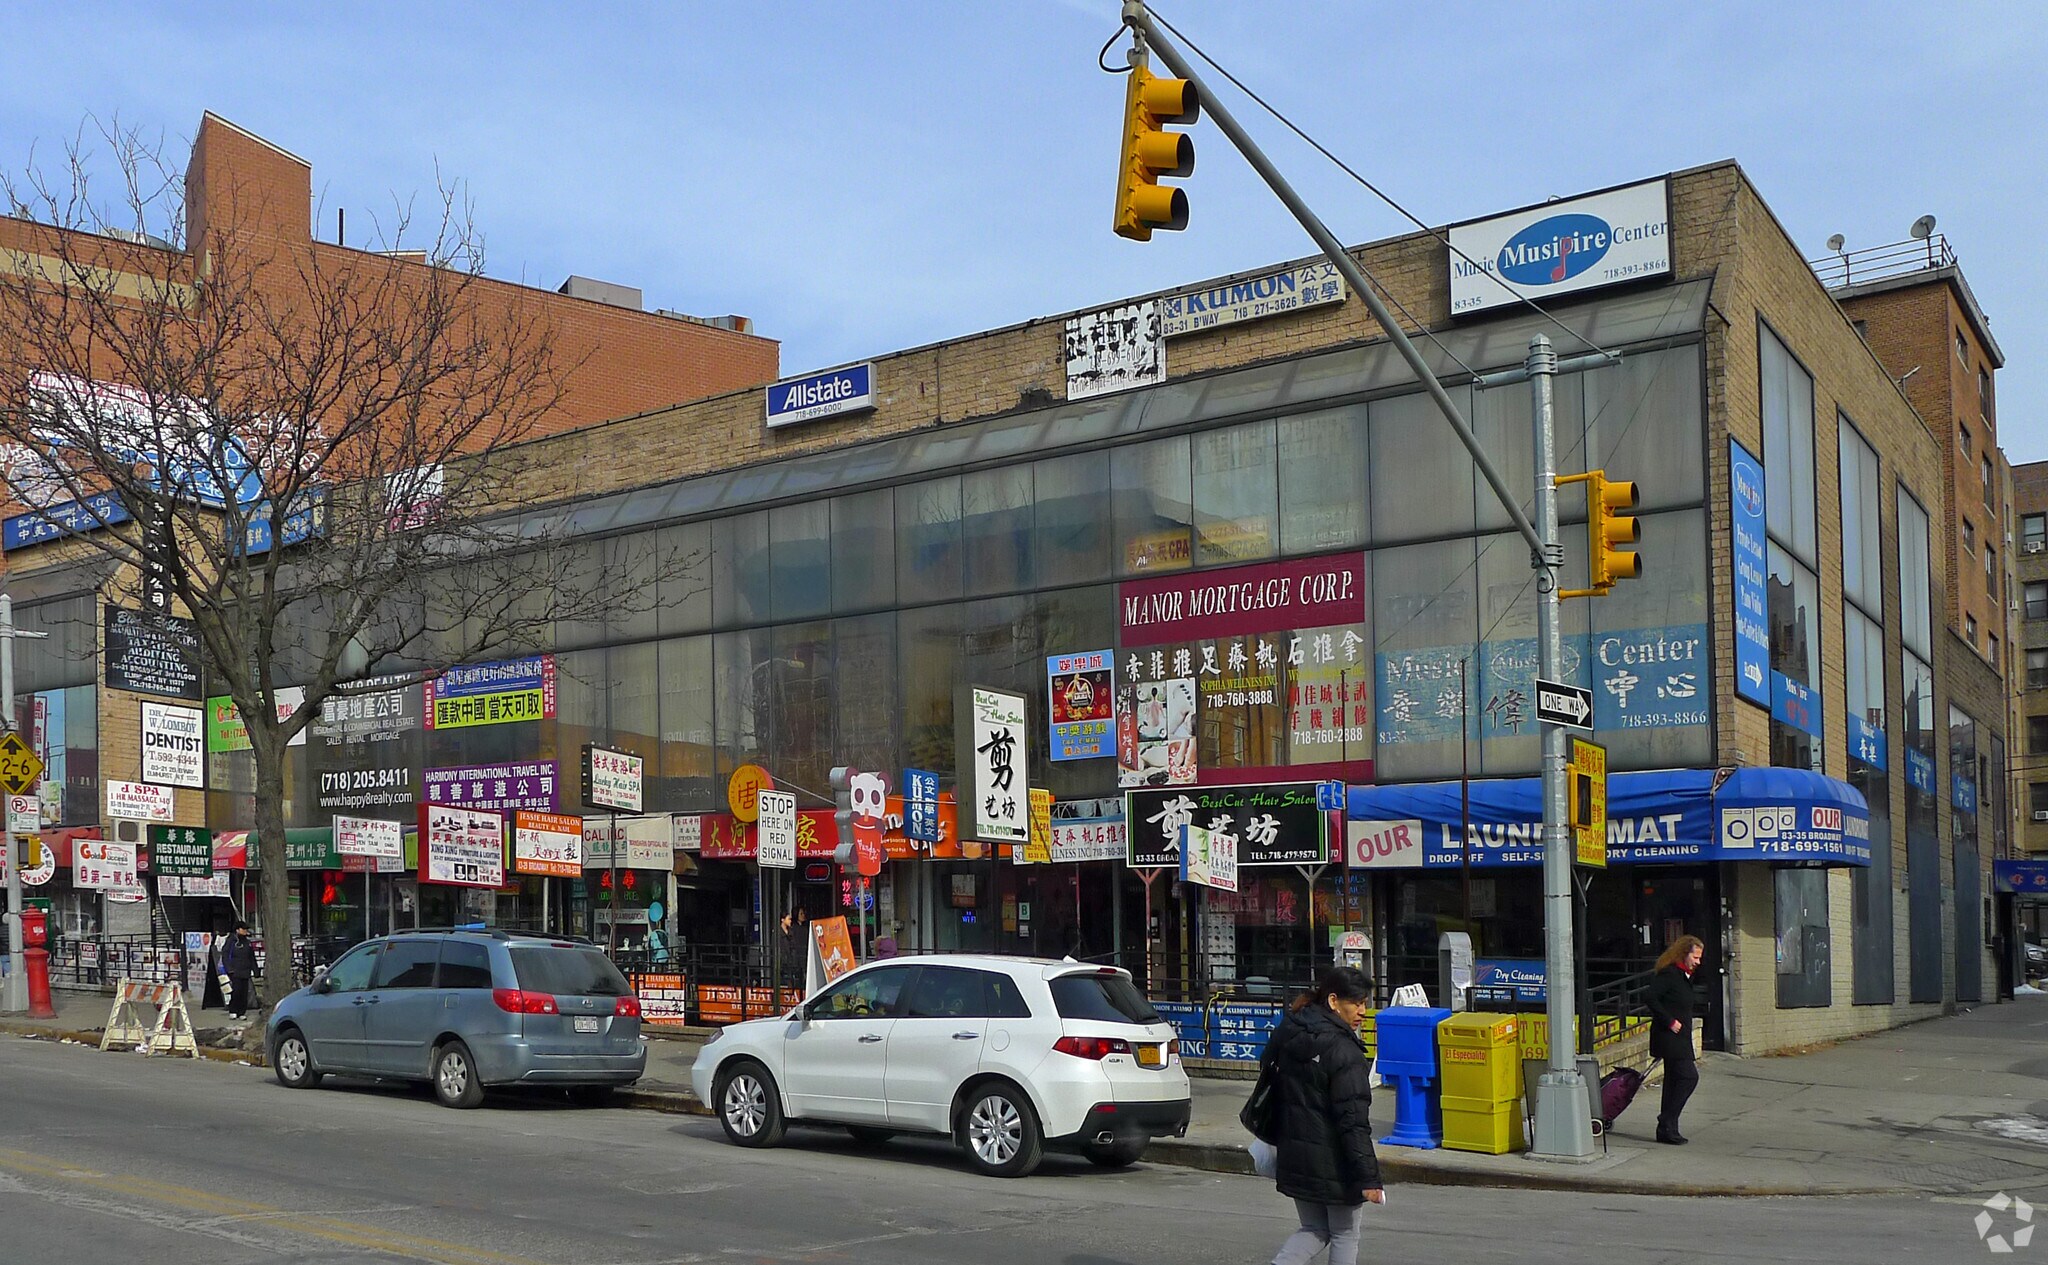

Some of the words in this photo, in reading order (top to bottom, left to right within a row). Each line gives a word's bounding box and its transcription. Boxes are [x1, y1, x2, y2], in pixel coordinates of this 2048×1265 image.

[1454, 256, 1494, 279] Music
[1504, 230, 1606, 279] Musipire
[1612, 221, 1668, 244] Center
[1301, 261, 1338, 284] 公文
[1604, 259, 1667, 279] 718-393-8866
[1187, 271, 1296, 314] KUMON
[1302, 280, 1338, 305] 數學
[1454, 296, 1482, 310] 83-35
[1164, 320, 1188, 334] 83-31
[1194, 313, 1219, 328] B'WAY
[1233, 307, 1247, 320] 718
[1255, 296, 1297, 315] 271-3626
[783, 376, 853, 410] Allstate
[795, 402, 842, 420] 718-699-6000
[1168, 539, 1189, 559] CPA
[1124, 591, 1183, 626] MANOR
[1189, 578, 1291, 617] MORTGAGE
[1300, 570, 1354, 605] CORP.
[1600, 637, 1699, 667] Center
[1059, 655, 1102, 671] 娛樂城
[177, 672, 196, 682] FLOOR
[1200, 679, 1226, 692] SOPHIA
[1227, 677, 1262, 690] WELLNESS
[1264, 675, 1278, 687] INC.
[1604, 669, 1697, 709] 中心
[1207, 690, 1273, 708] 718-760-3888
[1545, 693, 1562, 711] ONE
[1569, 697, 1585, 716] WAY
[149, 709, 163, 717] DR.
[324, 694, 403, 722] 富豪地產公司
[382, 719, 395, 729] REAL
[396, 717, 414, 727] ESTATE
[991, 709, 1005, 721] Hair
[1006, 711, 1024, 725] Salon
[1621, 710, 1707, 728] 718-393-8866
[145, 732, 201, 752] DENTIST
[327, 737, 341, 746] SALES
[347, 734, 366, 744] RENTAL
[370, 731, 400, 742] MORTGAGE
[1294, 728, 1363, 745] 718-760-2888
[977, 727, 1016, 791] 剪
[321, 771, 351, 793] (718)
[353, 767, 408, 789] 205.8411
[426, 770, 458, 783] HARMONY
[459, 767, 511, 781] INTERNATIONAL
[512, 765, 539, 777] TRAVEL
[541, 764, 555, 775] INC.
[121, 784, 129, 793] J
[134, 785, 160, 796] SPA
[429, 776, 553, 801] 親善旅遊公司
[629, 781, 640, 792] SPA
[128, 795, 157, 804] MASSAGE
[320, 790, 412, 808] www.happy8realty.com
[761, 796, 793, 815] STOP
[912, 774, 922, 834] KUMON
[1250, 793, 1279, 807] Hair
[1280, 790, 1316, 808] Salon
[520, 813, 540, 821] JESSIE
[542, 815, 558, 824] HAIR
[559, 817, 580, 826] SALON
[529, 822, 548, 830] BEAUTY
[762, 817, 781, 830] HERE
[784, 818, 794, 831] ON
[1813, 808, 1841, 828] OUR
[710, 814, 819, 849] 大河家
[769, 832, 786, 845] RED
[1781, 832, 1806, 840] 83-35
[1808, 831, 1842, 842] BROADWAY
[156, 843, 208, 856] RESTAURANT
[1356, 824, 1413, 863] OUR
[1635, 844, 1699, 858] CLEANING
[1760, 841, 1843, 854] 718-699-1561
[155, 855, 174, 865] FREE
[174, 856, 209, 867] DELIVERY
[762, 847, 793, 861] SIGNAL
[1135, 854, 1156, 863] 83-33
[1156, 853, 1180, 862] BROAD
[1250, 851, 1267, 861] TEL:
[33, 870, 51, 883] SALE
[161, 866, 175, 874] TEL:
[1021, 904, 1028, 916] B
[1494, 969, 1509, 982] Dry
[1220, 1019, 1256, 1037] 數學
[1220, 1042, 1256, 1058] 英文
[1445, 1048, 1453, 1058] El
[1453, 1049, 1486, 1060] Especialito
